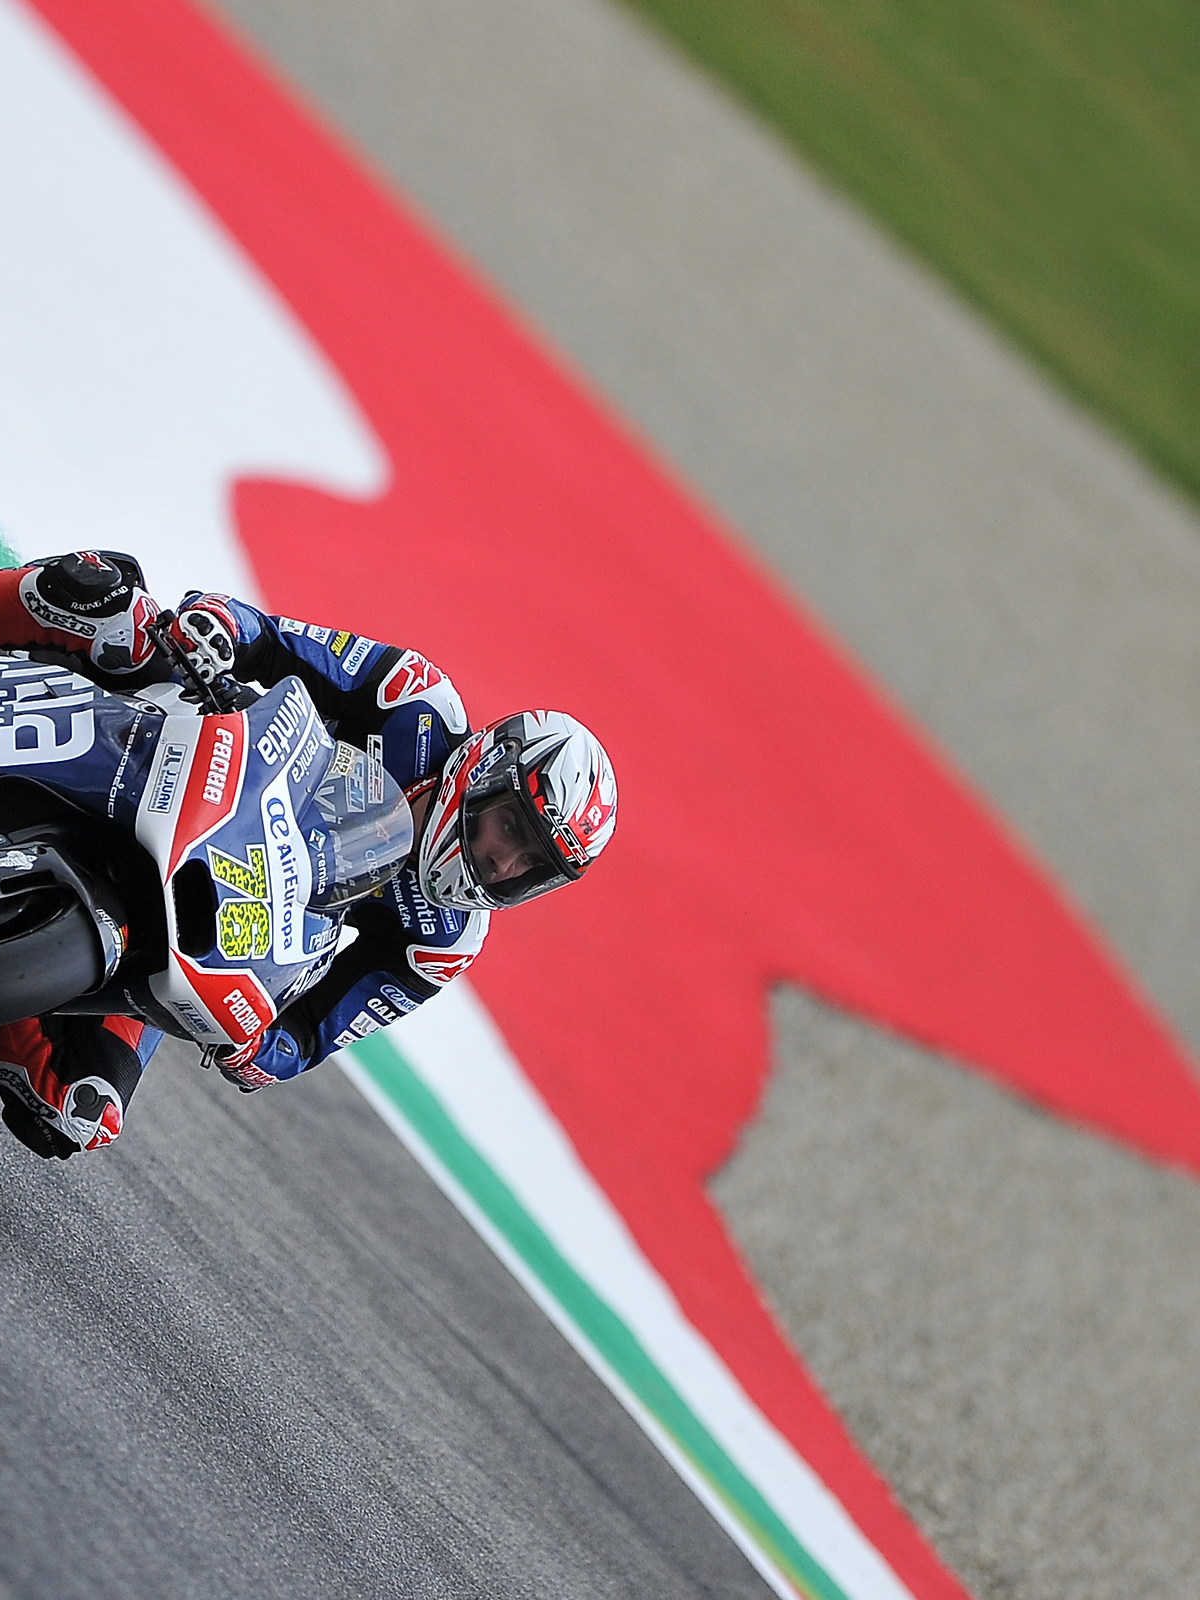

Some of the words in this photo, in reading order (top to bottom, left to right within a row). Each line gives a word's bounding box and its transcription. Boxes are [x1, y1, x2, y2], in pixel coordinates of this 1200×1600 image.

[256, 679, 308, 766] Avintia
[203, 727, 234, 805] PACHA
[316, 852, 329, 895] remica
[544, 803, 590, 865] LS2
[206, 843, 272, 961] 76
[277, 843, 299, 950] AirEuropa
